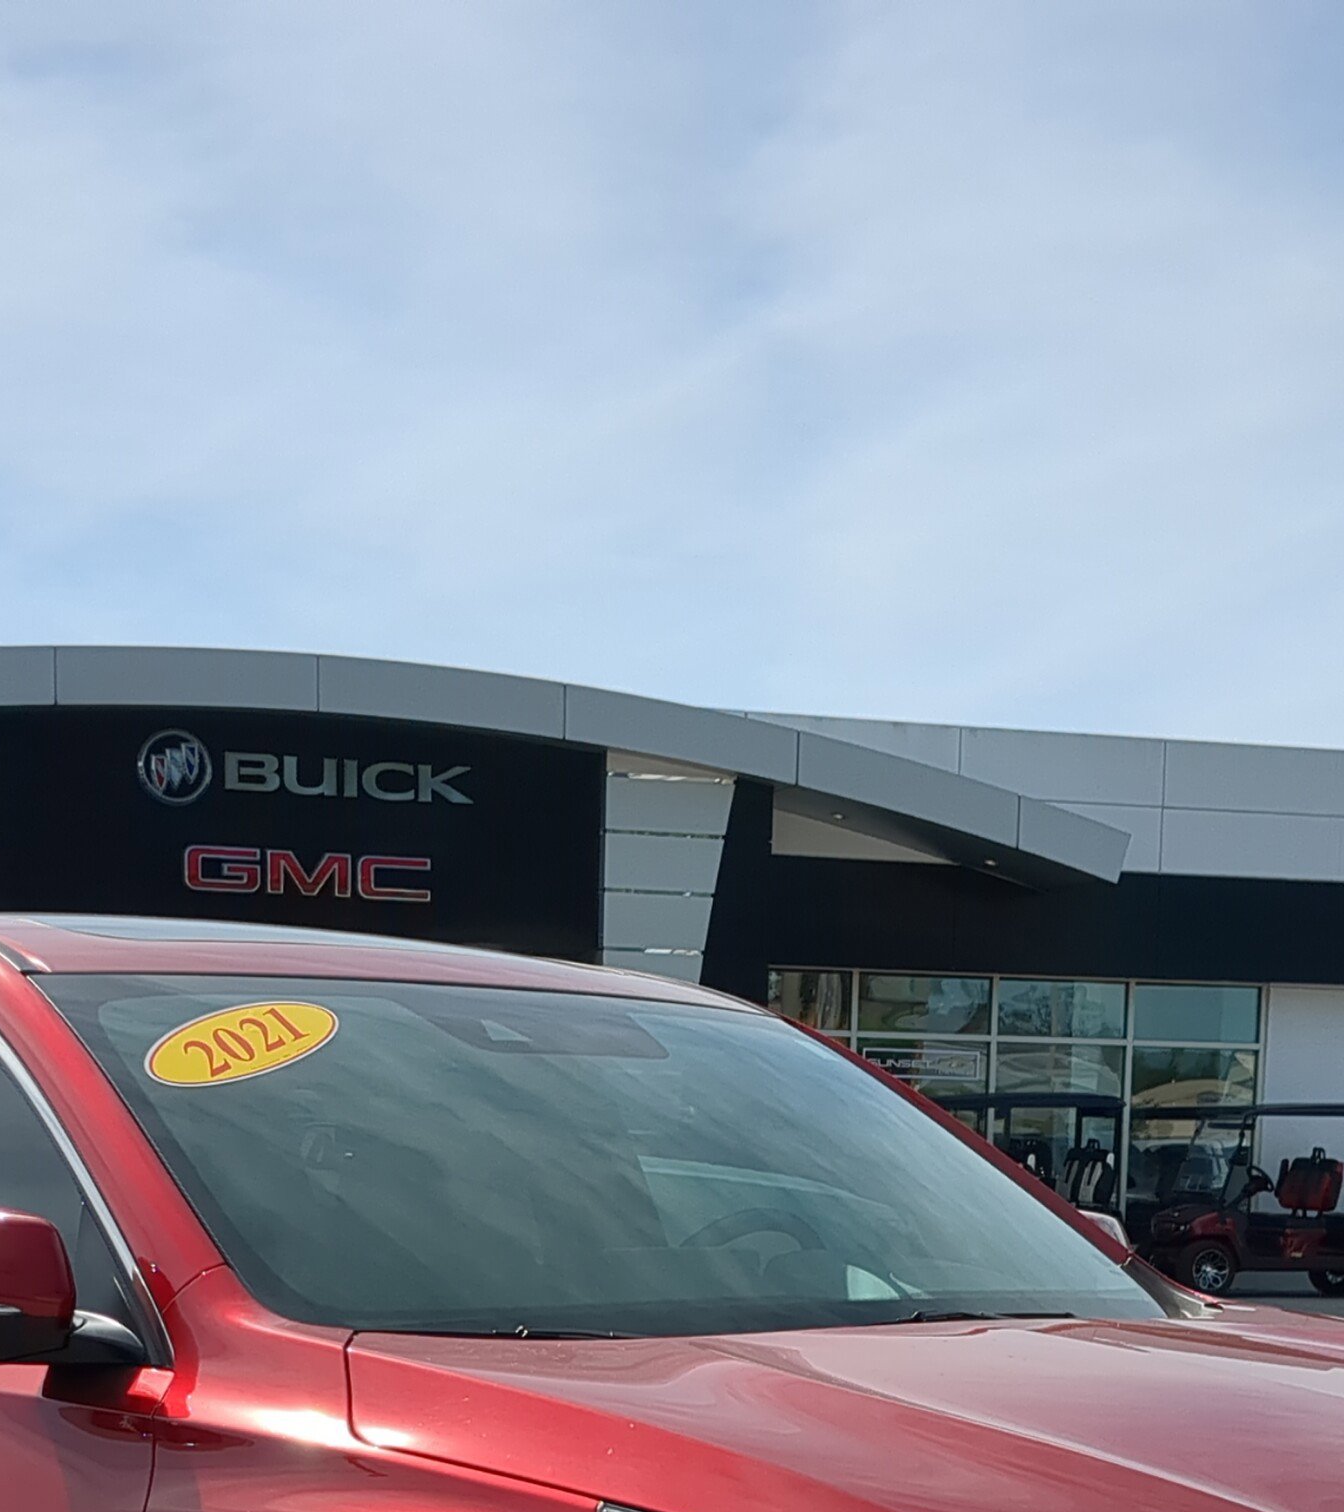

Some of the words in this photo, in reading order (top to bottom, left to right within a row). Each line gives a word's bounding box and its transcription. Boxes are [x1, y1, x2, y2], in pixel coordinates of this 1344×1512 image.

[223, 750, 475, 805] BUICK
[184, 845, 431, 901] GMC
[182, 1007, 311, 1078] 2021
